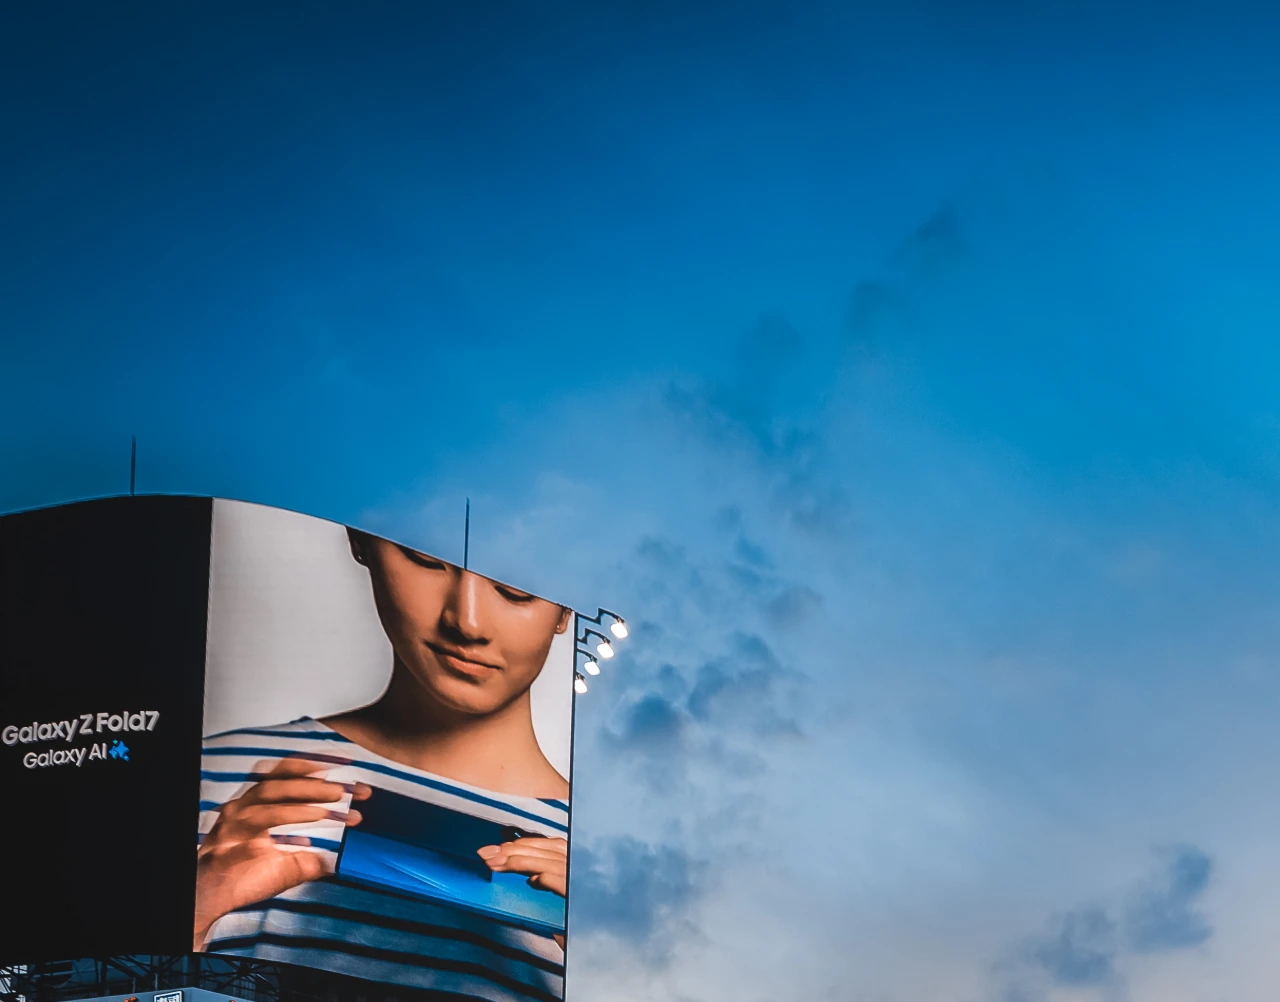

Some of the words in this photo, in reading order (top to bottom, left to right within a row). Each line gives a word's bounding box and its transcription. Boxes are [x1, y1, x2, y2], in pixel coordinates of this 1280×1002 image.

[1, 718, 78, 746] Galaxy
[79, 714, 93, 735] Z
[96, 710, 160, 733] Fold7
[23, 746, 86, 769] Galaxy
[89, 743, 107, 761] AI
